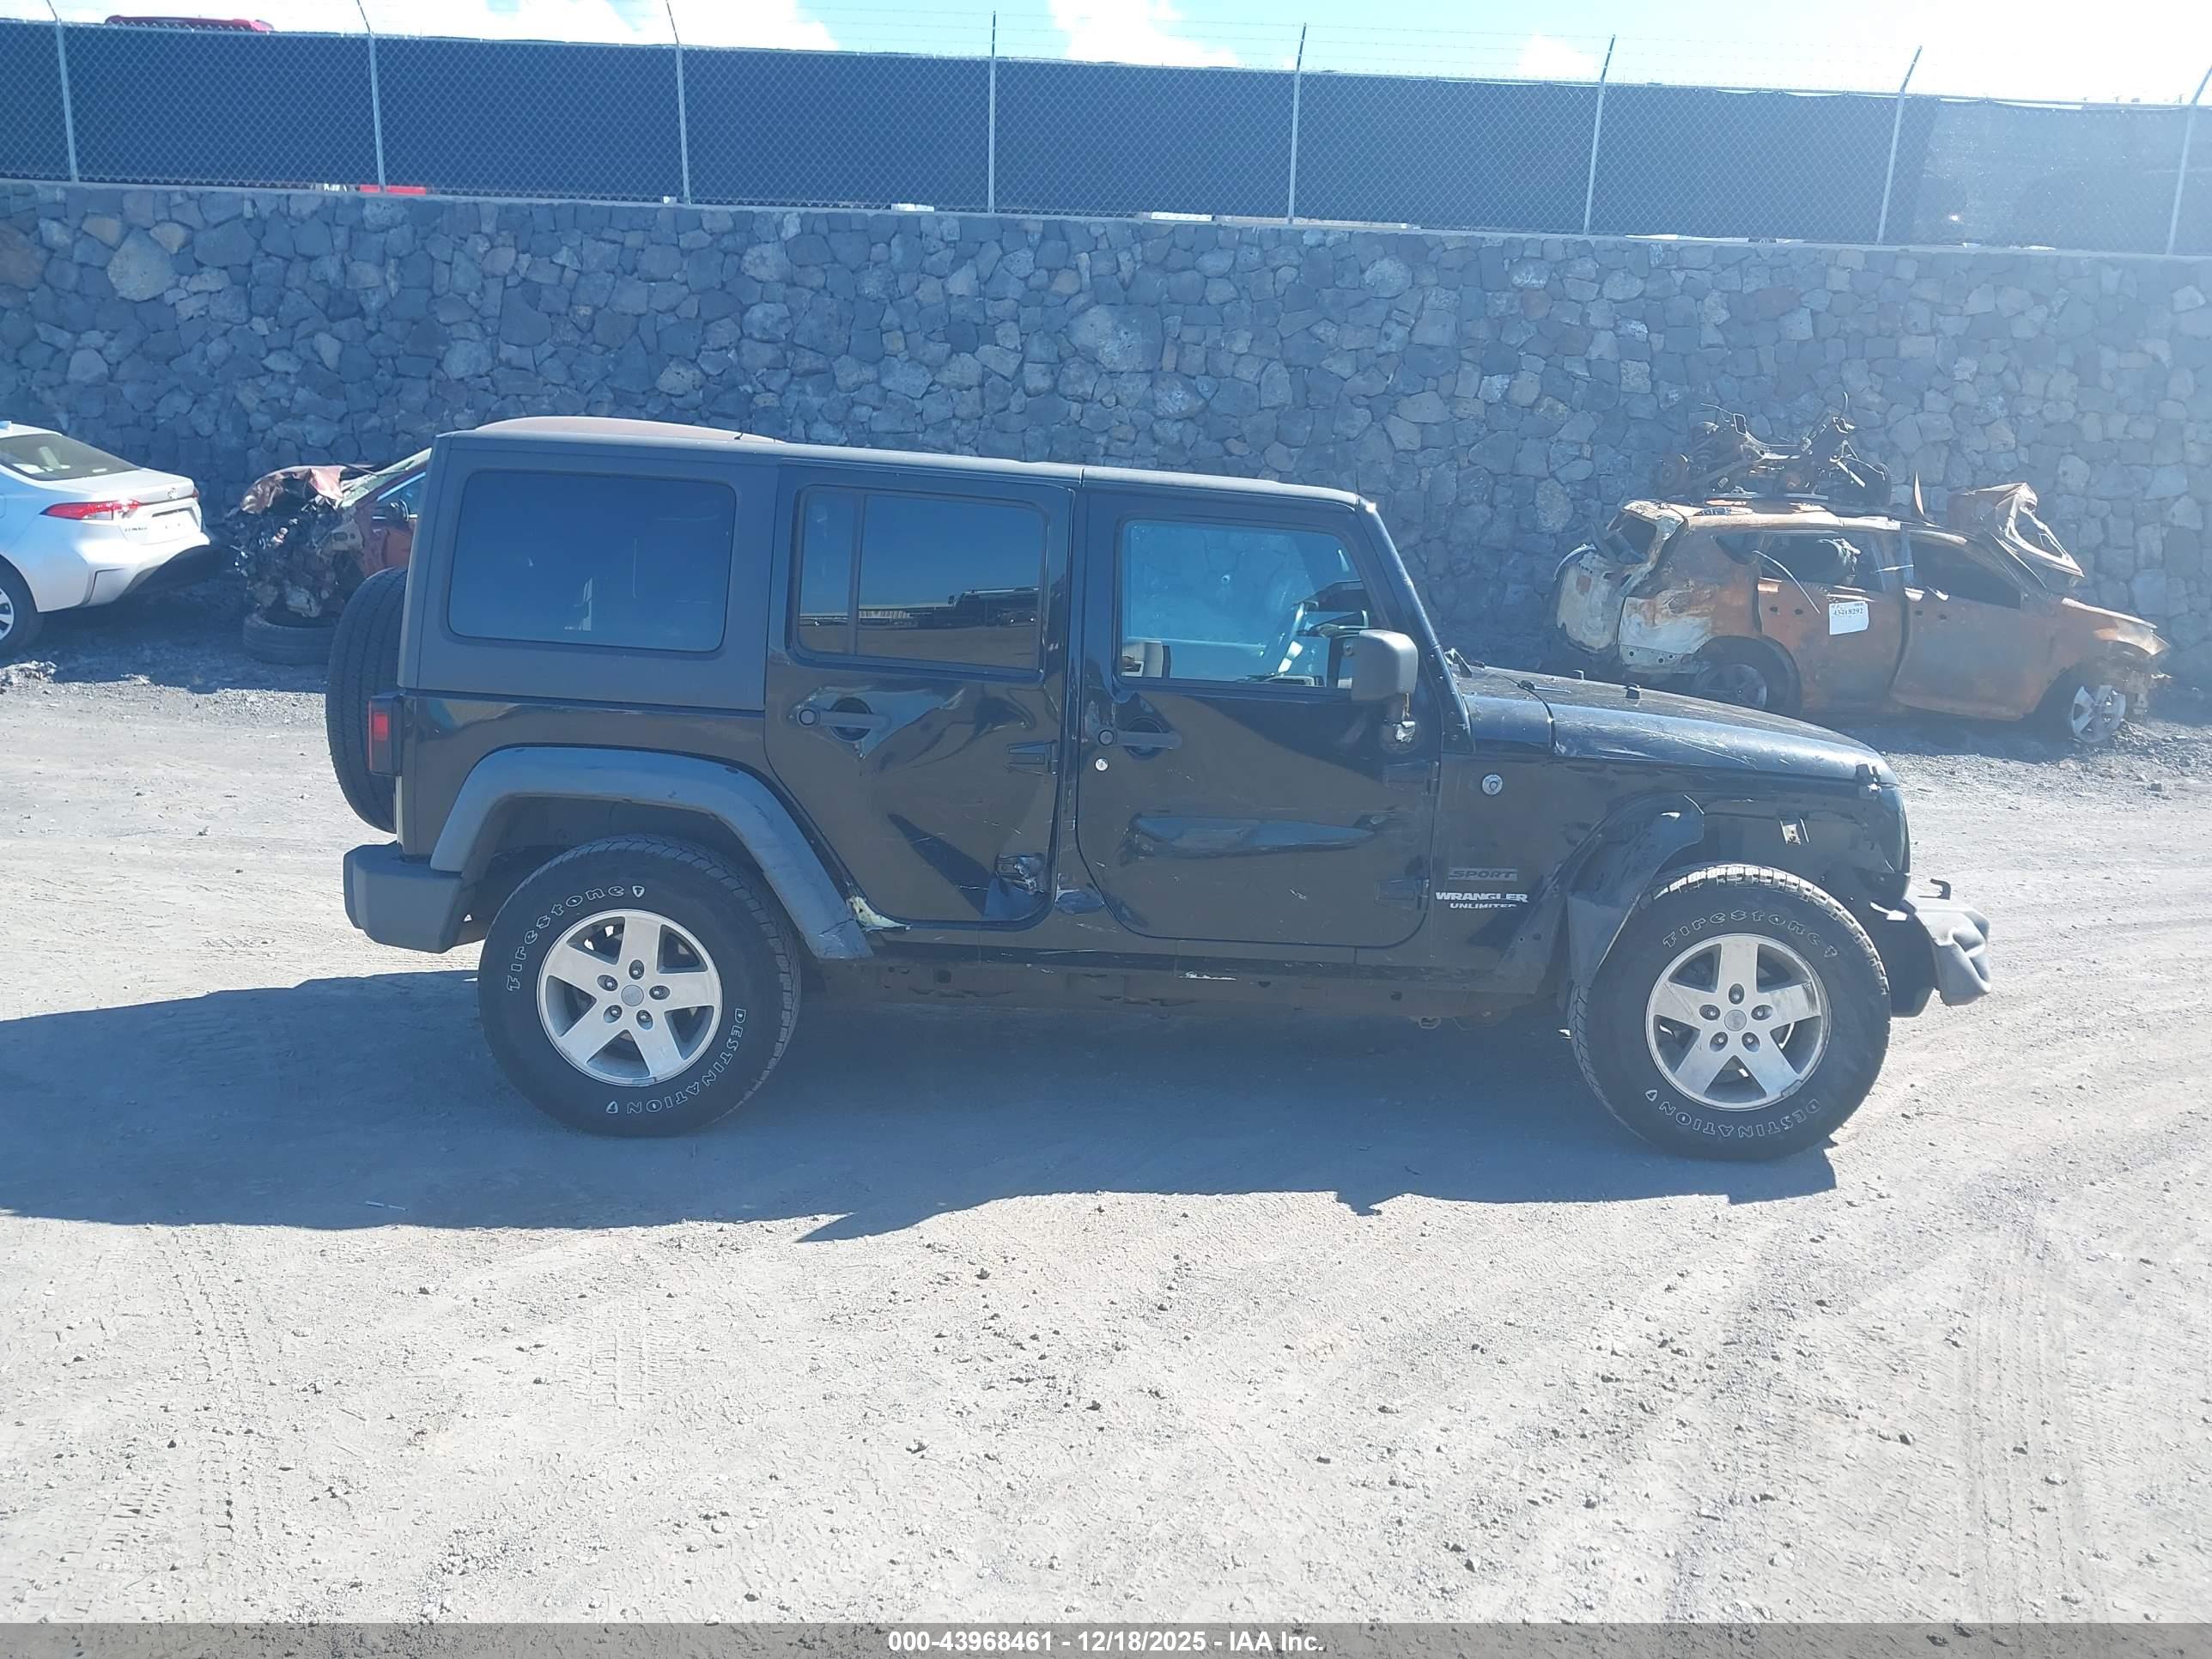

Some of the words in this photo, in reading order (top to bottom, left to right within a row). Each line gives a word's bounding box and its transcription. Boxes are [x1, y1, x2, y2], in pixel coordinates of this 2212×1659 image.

[1449, 870, 1516, 879] SPORT
[1435, 891, 1529, 903] WRANGLER
[506, 884, 626, 992] Firestone
[1662, 908, 1820, 949] Firestone
[626, 1008, 747, 1115] DESTINATION
[1658, 1098, 1821, 1139] DESTINATION
